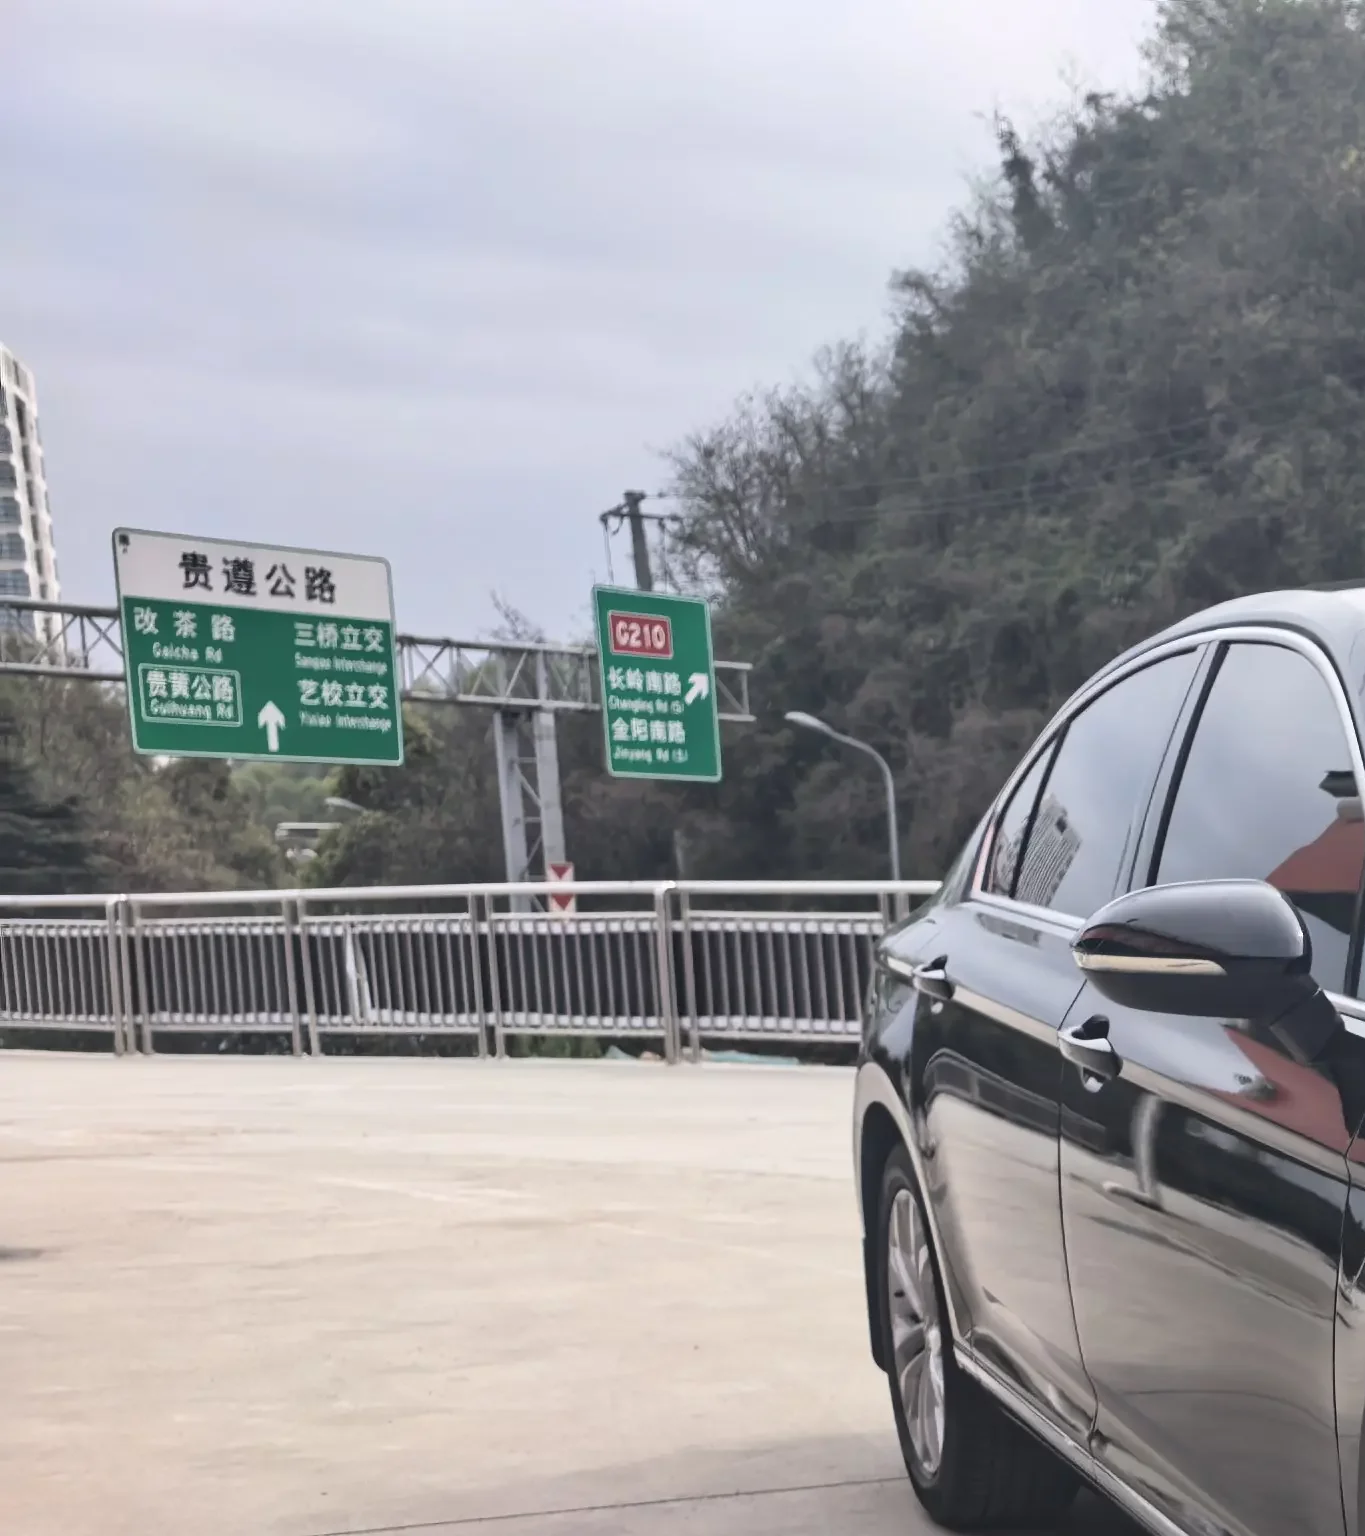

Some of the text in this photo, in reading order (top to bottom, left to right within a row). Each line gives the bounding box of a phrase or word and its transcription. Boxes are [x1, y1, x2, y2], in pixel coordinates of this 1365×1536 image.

[178, 551, 337, 603] 贵遵公路
[133, 606, 236, 642] 改茶路
[293, 621, 385, 653] 三桥立交
[615, 620, 666, 650] G210
[205, 645, 223, 664] Rd
[146, 669, 234, 703] 贵黄公路
[297, 678, 389, 710] 艺校立交
